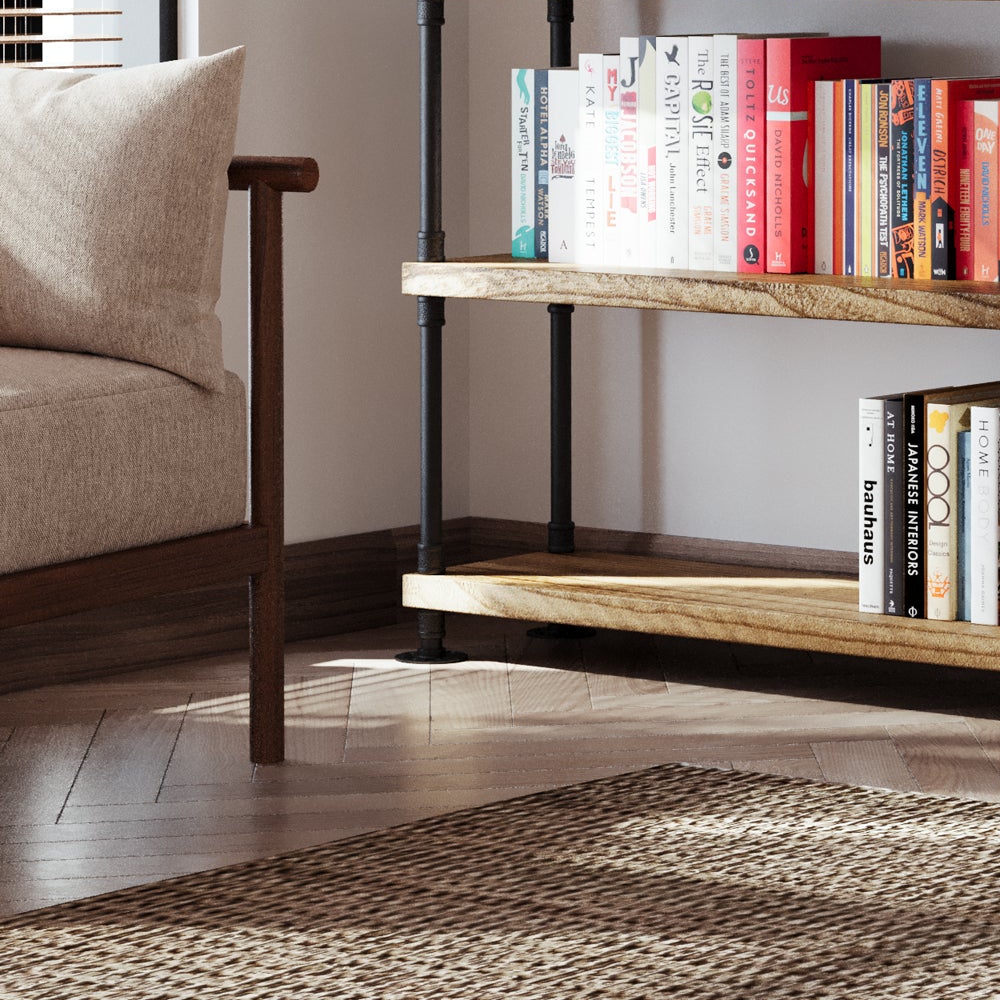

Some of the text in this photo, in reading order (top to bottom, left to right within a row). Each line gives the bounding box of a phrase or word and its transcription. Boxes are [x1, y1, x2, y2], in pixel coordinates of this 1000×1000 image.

[540, 127, 548, 166] ALPHA
[696, 50, 709, 193] The Effect
[586, 87, 595, 247] KATE TEMPEST
[745, 68, 756, 237] TOLTZ QUICKSAND
[879, 90, 888, 246] JON RONSON THE PSYCHOPATH TEST
[933, 150, 946, 193] OSTRICH
[669, 187, 677, 233] Lanchester
[960, 169, 970, 204] NINETEEN
[918, 201, 926, 258] MARK WATSON
[887, 412, 895, 472] AT HOME
[979, 420, 988, 477] HOME
[864, 480, 877, 565] bauhaus
[908, 443, 918, 575] JAPANESE INTERIORS
